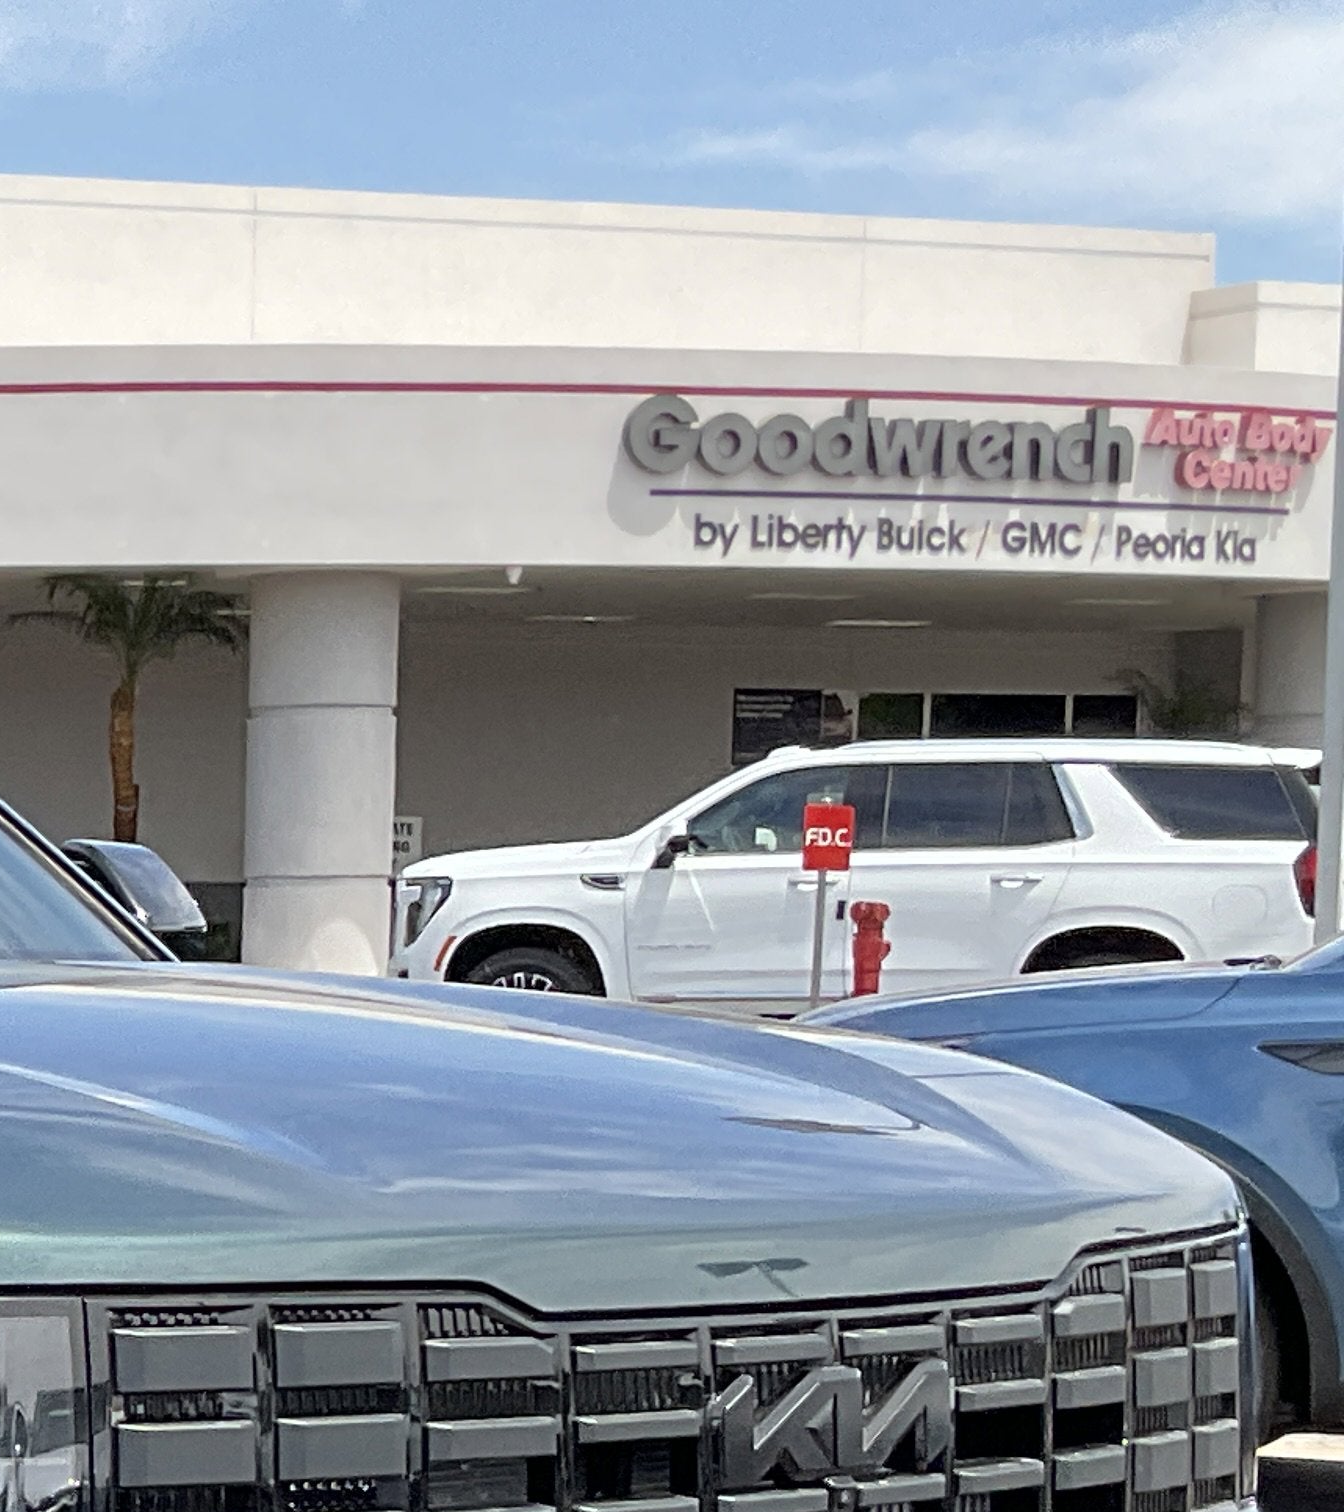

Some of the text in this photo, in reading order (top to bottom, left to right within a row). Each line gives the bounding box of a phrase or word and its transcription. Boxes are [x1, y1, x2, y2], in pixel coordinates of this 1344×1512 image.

[622, 394, 1134, 484] Goodwrench
[1144, 407, 1332, 462] Auto Body
[1175, 451, 1302, 492] Center
[694, 514, 739, 558] by
[751, 514, 866, 560] Liberty
[876, 517, 966, 552] Buick
[1001, 522, 1082, 557] GMC
[1115, 525, 1205, 560] Peoria
[1215, 529, 1256, 562] Kia
